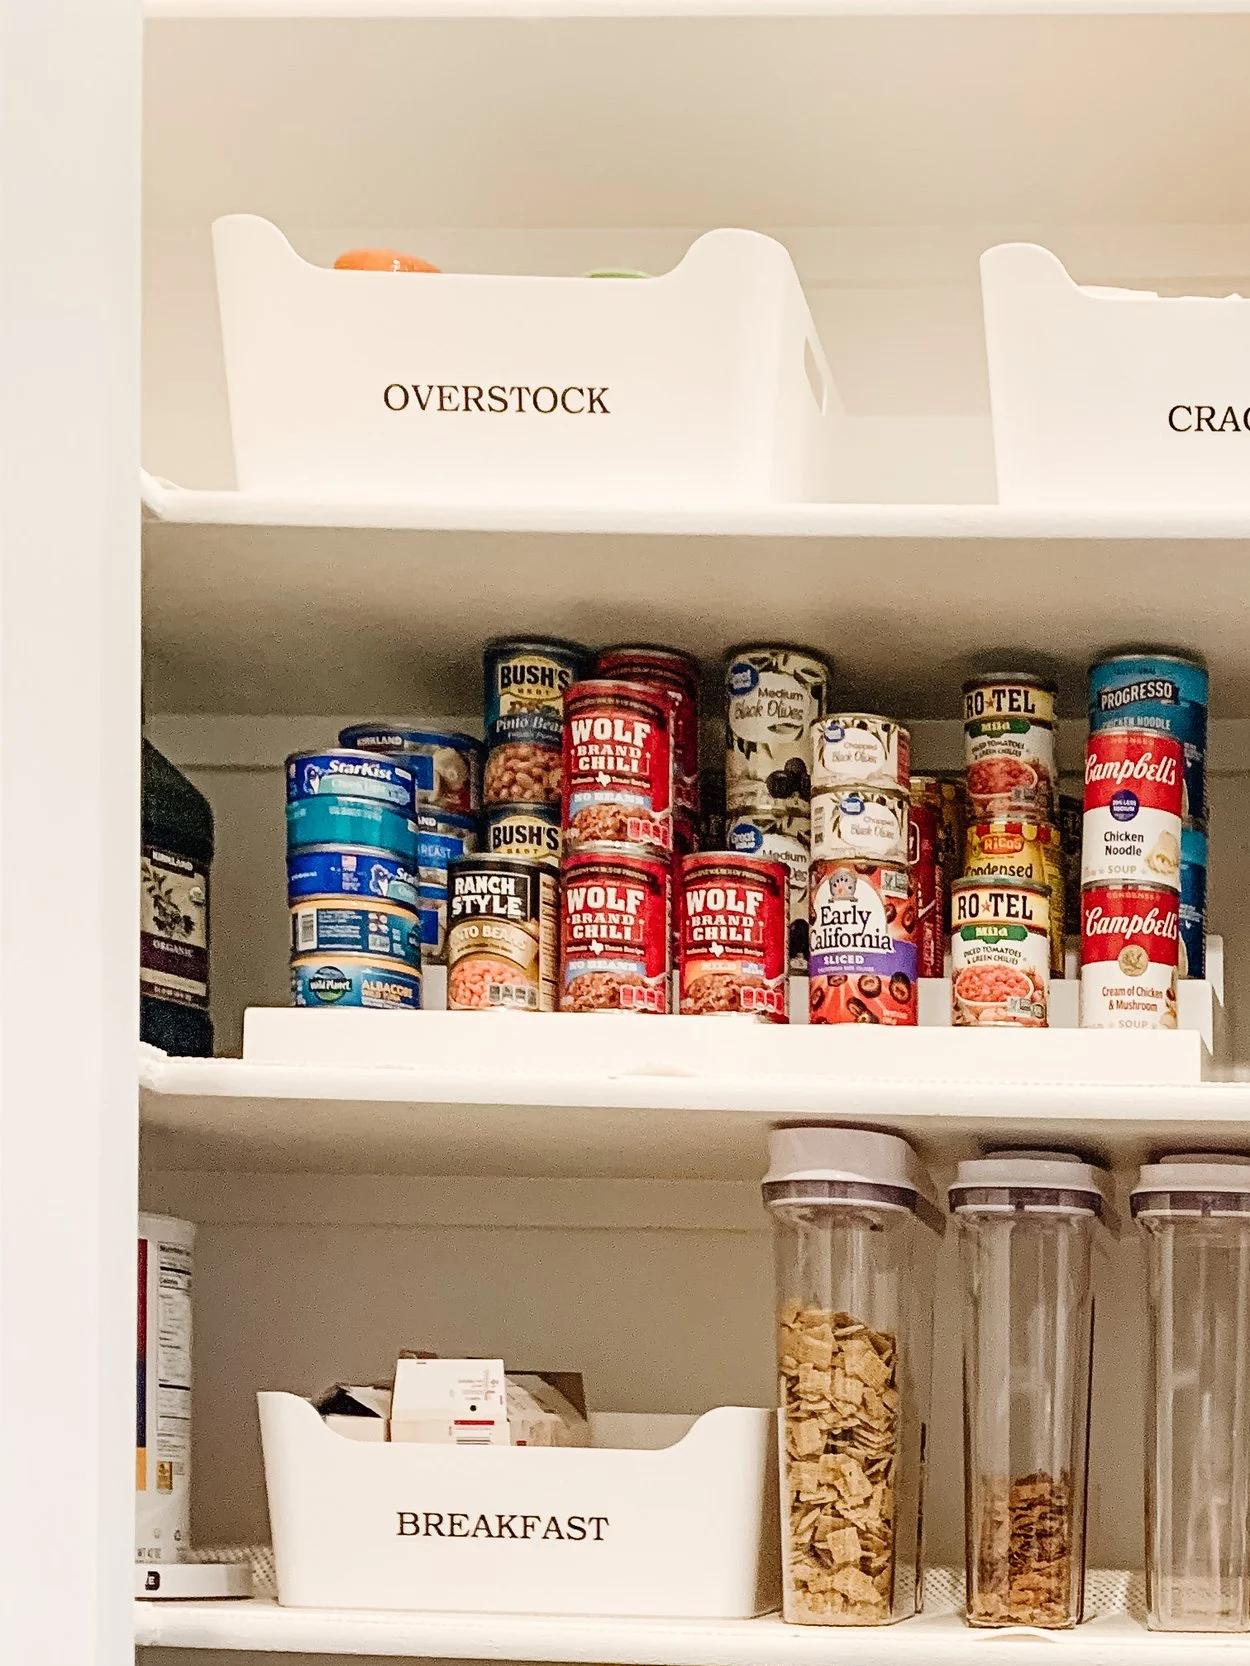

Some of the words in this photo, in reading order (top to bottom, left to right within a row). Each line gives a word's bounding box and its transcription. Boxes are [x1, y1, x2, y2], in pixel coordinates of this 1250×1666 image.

[383, 383, 611, 415] OVERSTOCK
[500, 664, 570, 692] BUSH'S
[757, 687, 804, 700] Medium
[1100, 681, 1173, 711] PROGRESSO
[735, 699, 764, 720] Black
[571, 717, 651, 748] WOLF
[577, 744, 642, 759] BRAND
[329, 759, 393, 780] StarKist
[578, 756, 639, 773] CHILI
[1084, 752, 1177, 786] Campbell's
[492, 824, 559, 850] BUSH'S
[1103, 831, 1145, 843] Chicken
[1105, 845, 1143, 857] Noodle
[965, 862, 1033, 879] Condensed
[1107, 865, 1137, 874] SOUP
[455, 876, 516, 895] RANCH
[451, 894, 525, 918] STYLE
[566, 886, 645, 915] WOLF
[686, 888, 763, 916] WOLF
[571, 912, 635, 926] BRAND
[691, 915, 755, 928] BRAND
[820, 904, 873, 936] Early
[1085, 906, 1178, 940] Campbell's
[572, 924, 632, 940] CHILI
[692, 926, 752, 942] CHILI
[810, 927, 892, 952] California
[823, 955, 865, 965] SLICED
[1101, 986, 1126, 998] Cream
[1126, 985, 1135, 997] of
[1135, 986, 1164, 999] Chicken
[1108, 1000, 1115, 1011] &
[1115, 1000, 1158, 1013] Mushroom
[1118, 1019, 1149, 1029] SOUP
[396, 1511, 610, 1541] BREAKFAST
